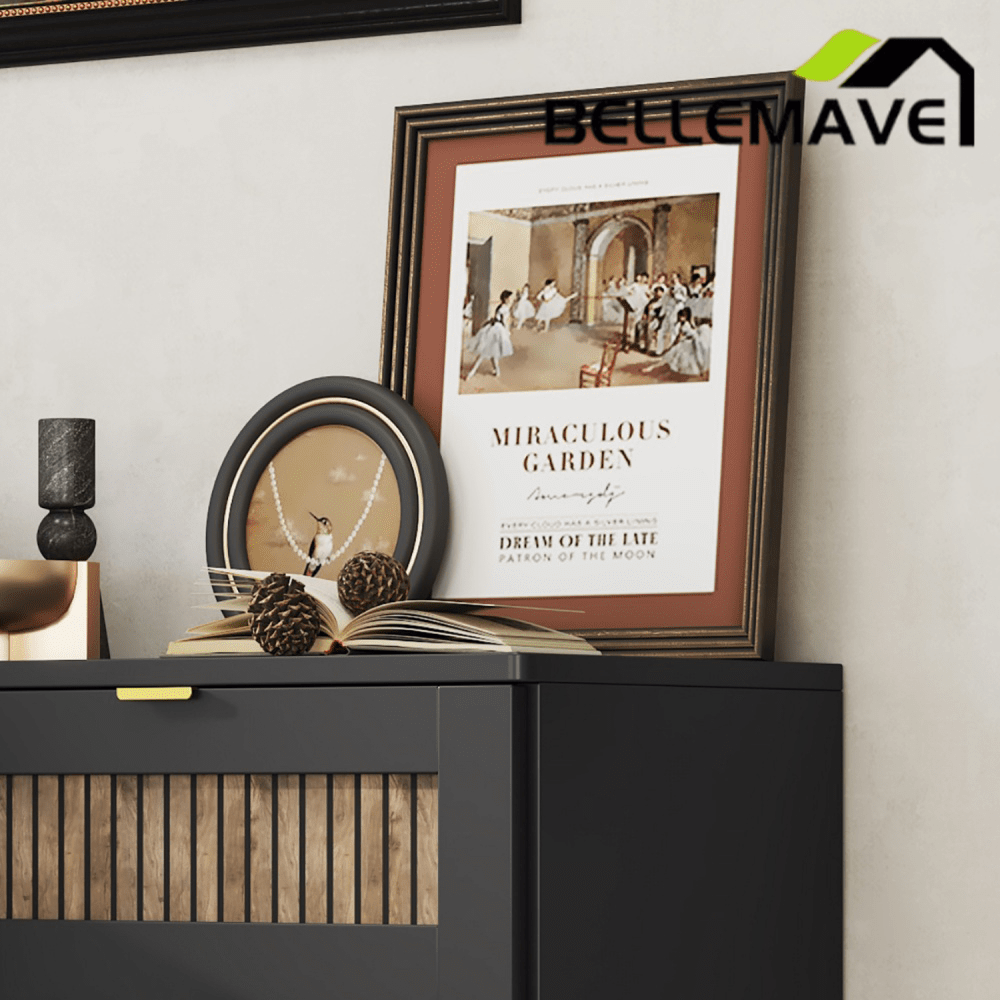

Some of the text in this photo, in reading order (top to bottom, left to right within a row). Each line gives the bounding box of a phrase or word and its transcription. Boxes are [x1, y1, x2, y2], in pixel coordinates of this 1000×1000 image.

[491, 419, 671, 447] MIRACULOUS
[523, 448, 634, 473] GARDEN
[500, 531, 658, 549] DREAM OF THE LATE
[499, 549, 656, 563] PATRON OF THE MOON
